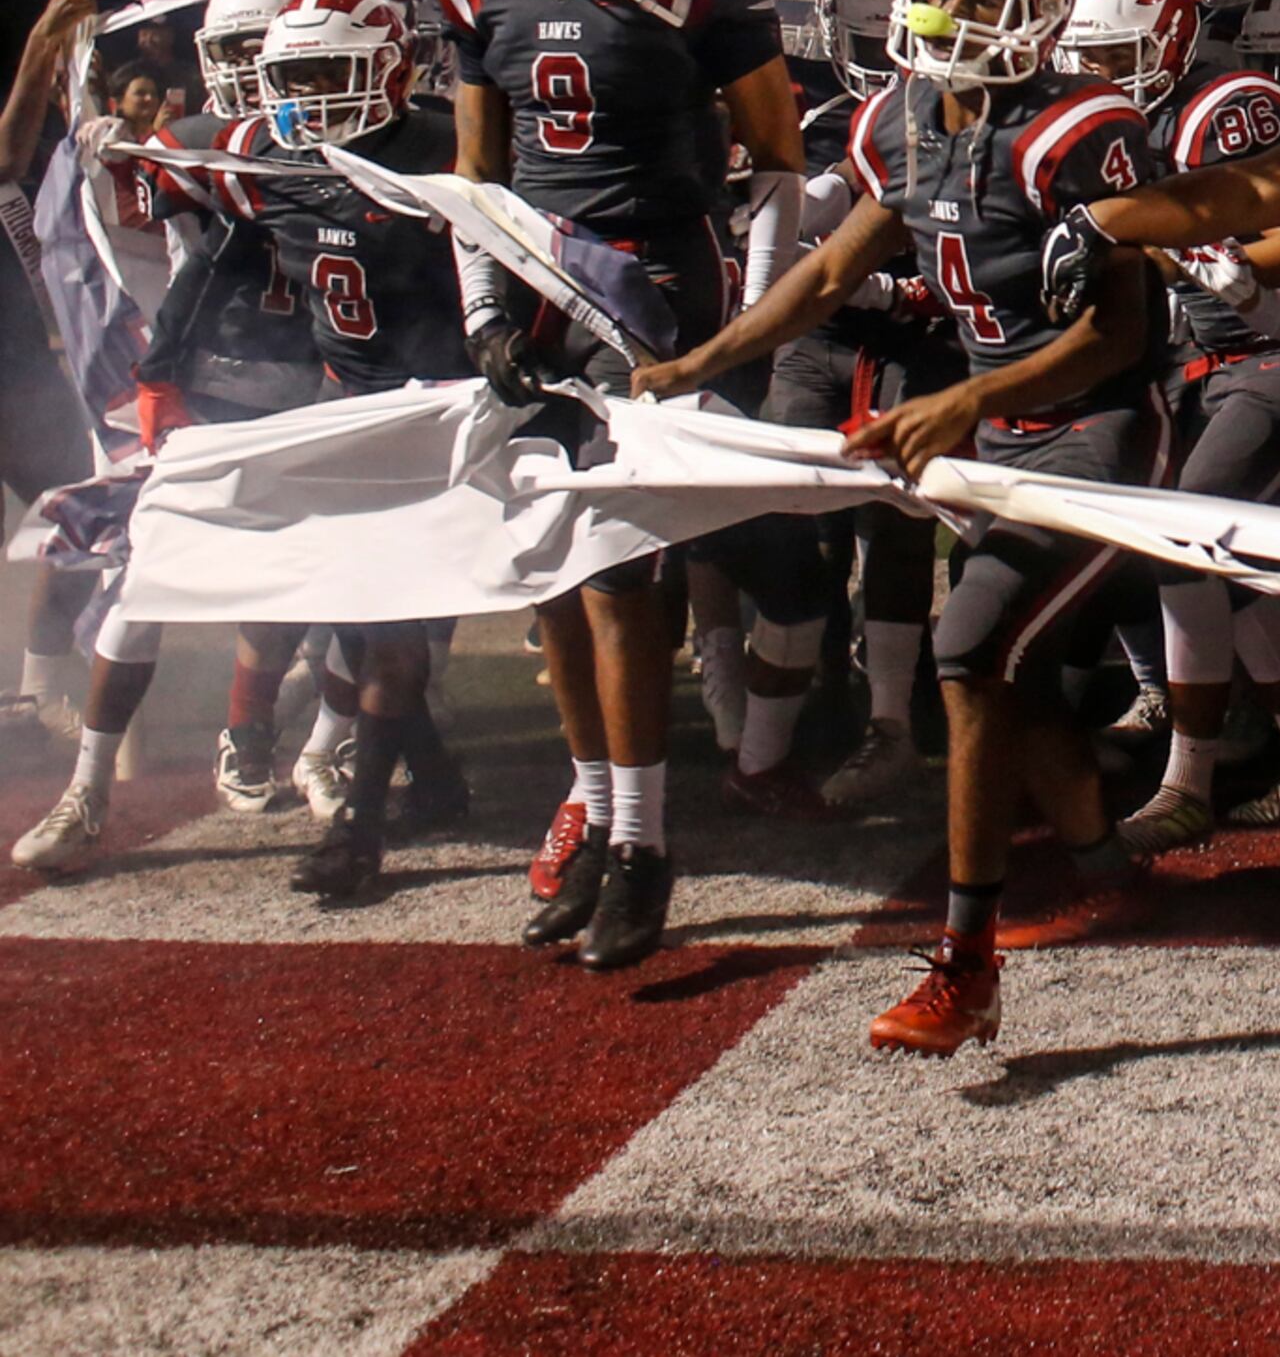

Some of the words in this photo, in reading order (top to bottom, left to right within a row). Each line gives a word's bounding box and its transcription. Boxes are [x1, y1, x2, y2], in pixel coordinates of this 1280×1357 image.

[537, 21, 582, 40] HAWKS
[531, 52, 594, 155] 9
[1213, 96, 1280, 156] 86
[1100, 137, 1139, 191] 4
[317, 227, 356, 247] HAWKS
[311, 252, 377, 340] 8
[936, 231, 1006, 343] 4
